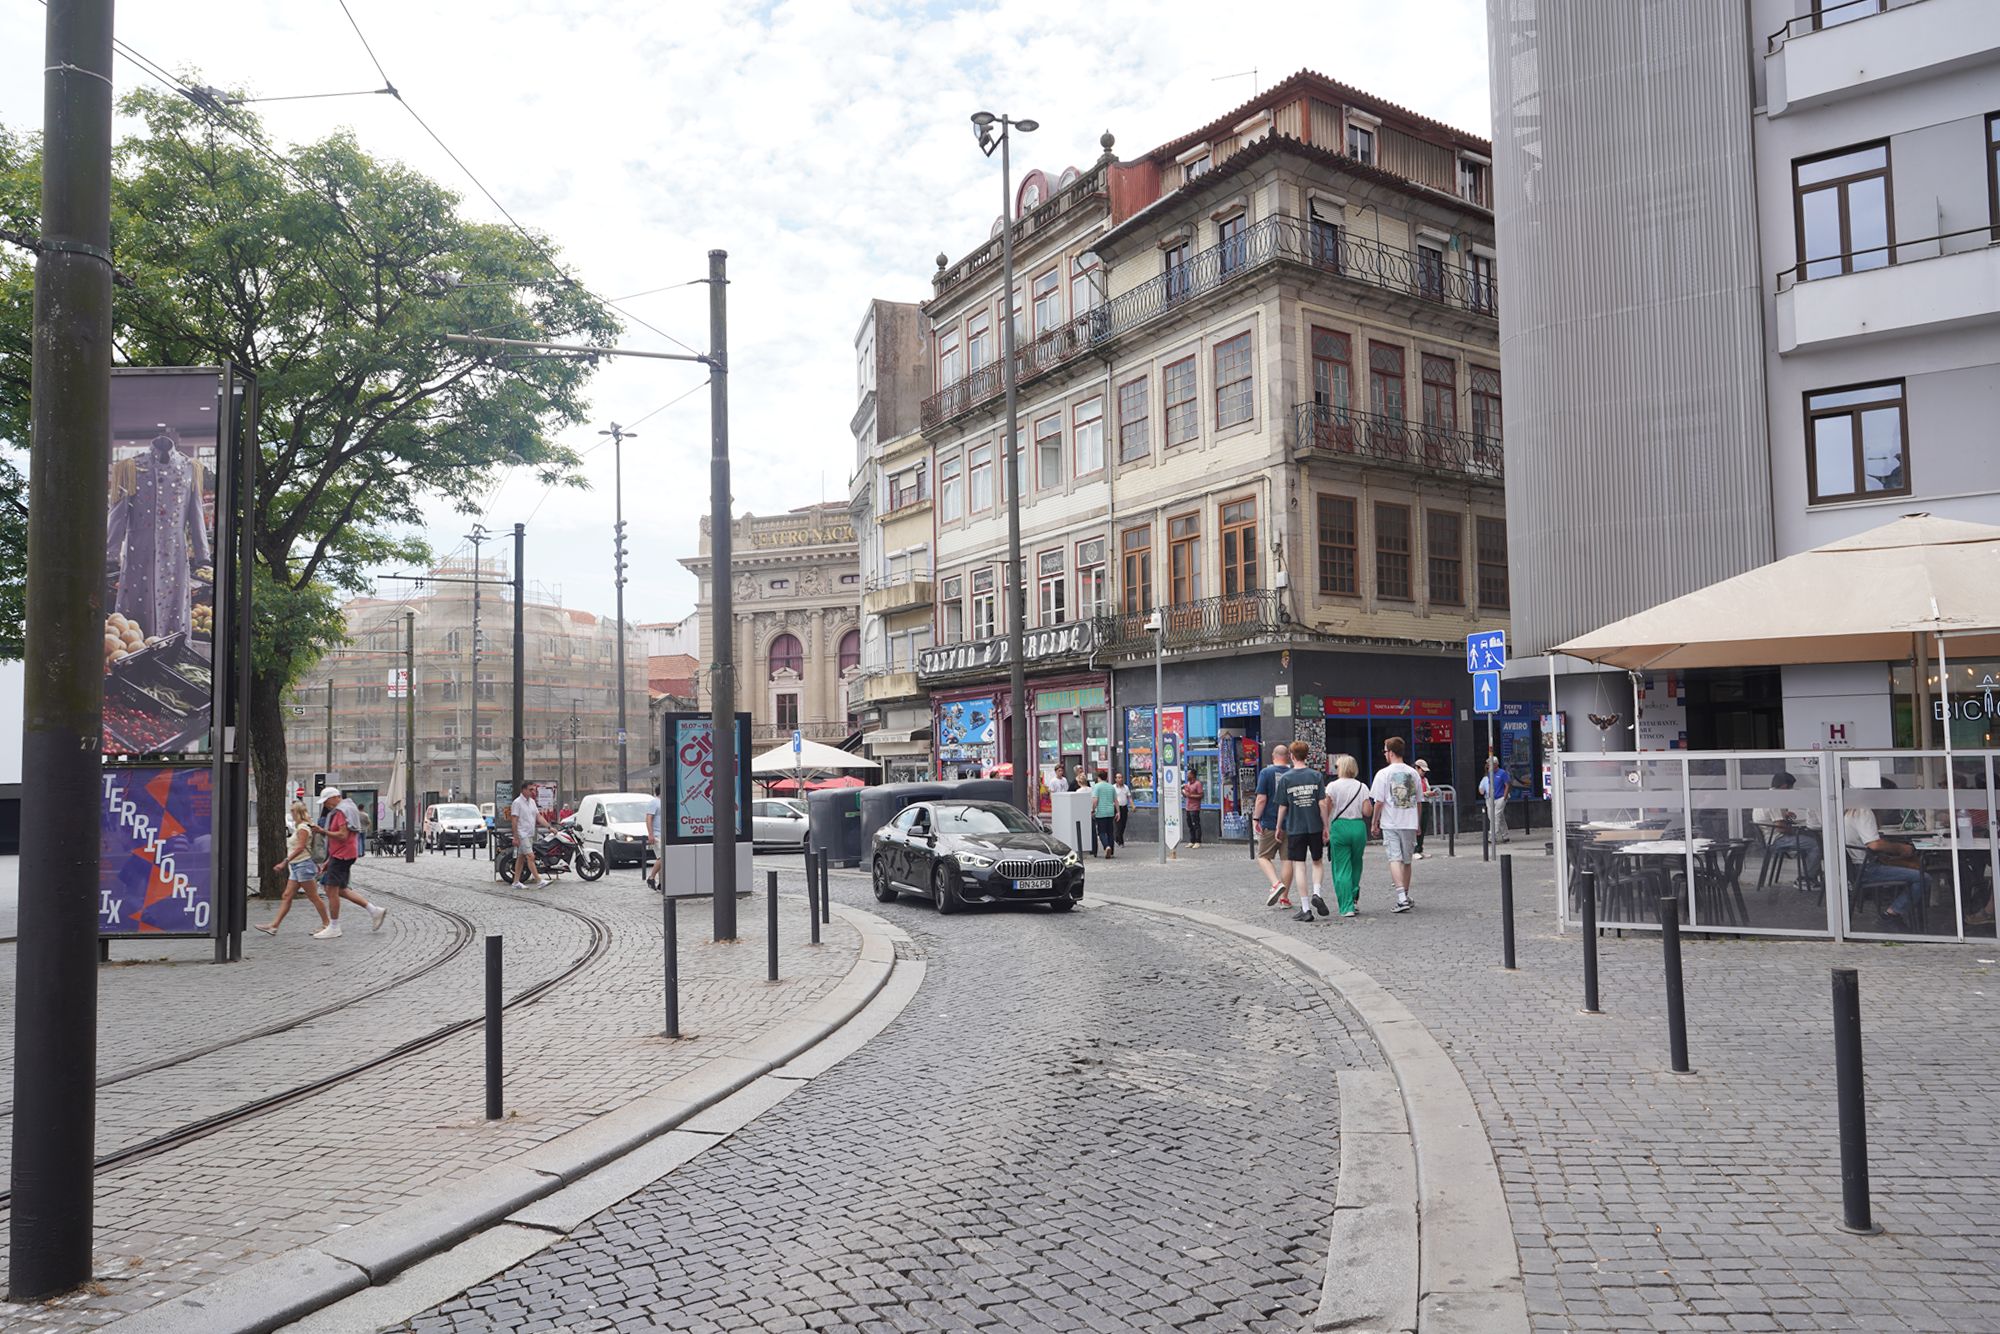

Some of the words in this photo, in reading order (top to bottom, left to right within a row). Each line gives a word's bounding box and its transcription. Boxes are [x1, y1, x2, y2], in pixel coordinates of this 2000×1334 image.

[751, 529, 809, 546] TEATRO
[925, 646, 976, 673] TATTOO
[1000, 627, 1080, 663] PRCING
[1222, 701, 1259, 714] TICKETS
[1503, 722, 1528, 731] AVEIRO
[1830, 723, 1846, 740] H
[1165, 749, 1173, 759] 20
[681, 815, 716, 825] Circuit
[103, 773, 210, 927] TERRITÓRIO
